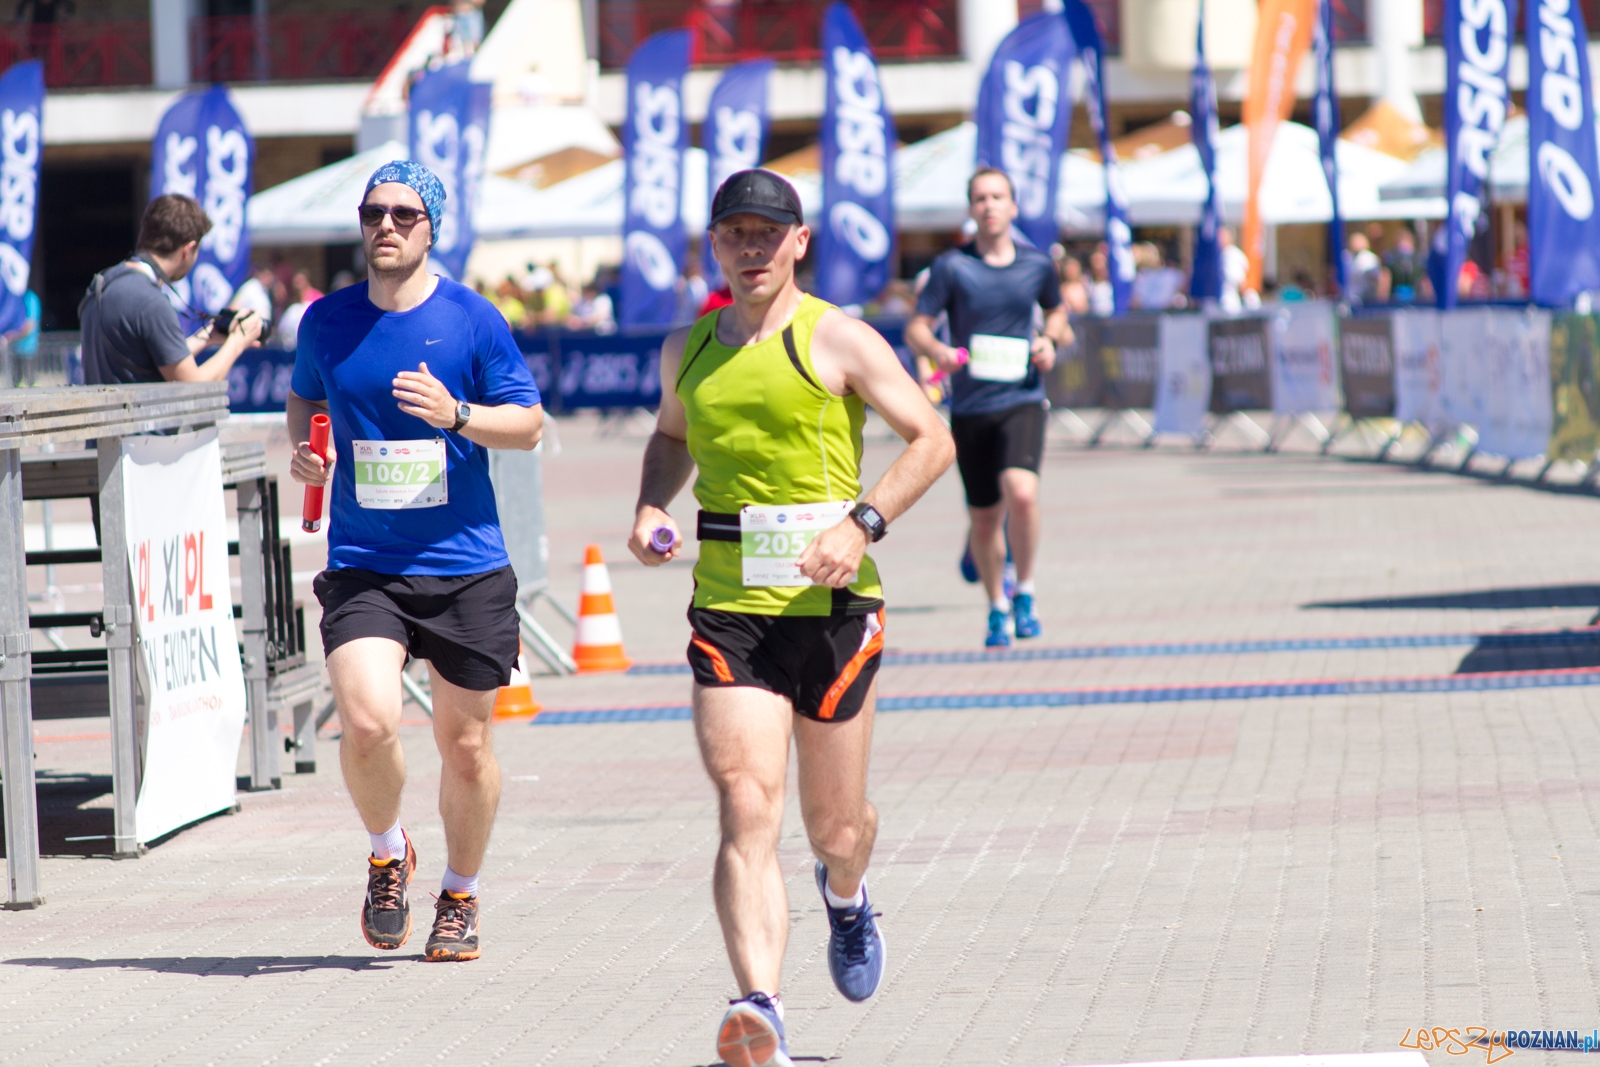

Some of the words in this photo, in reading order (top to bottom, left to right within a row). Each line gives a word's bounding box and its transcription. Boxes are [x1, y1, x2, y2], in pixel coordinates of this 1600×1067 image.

[365, 463, 430, 484] 106/2
[754, 531, 820, 555] 205
[163, 530, 213, 617] XLPL
[163, 626, 221, 691] EKIDEN
